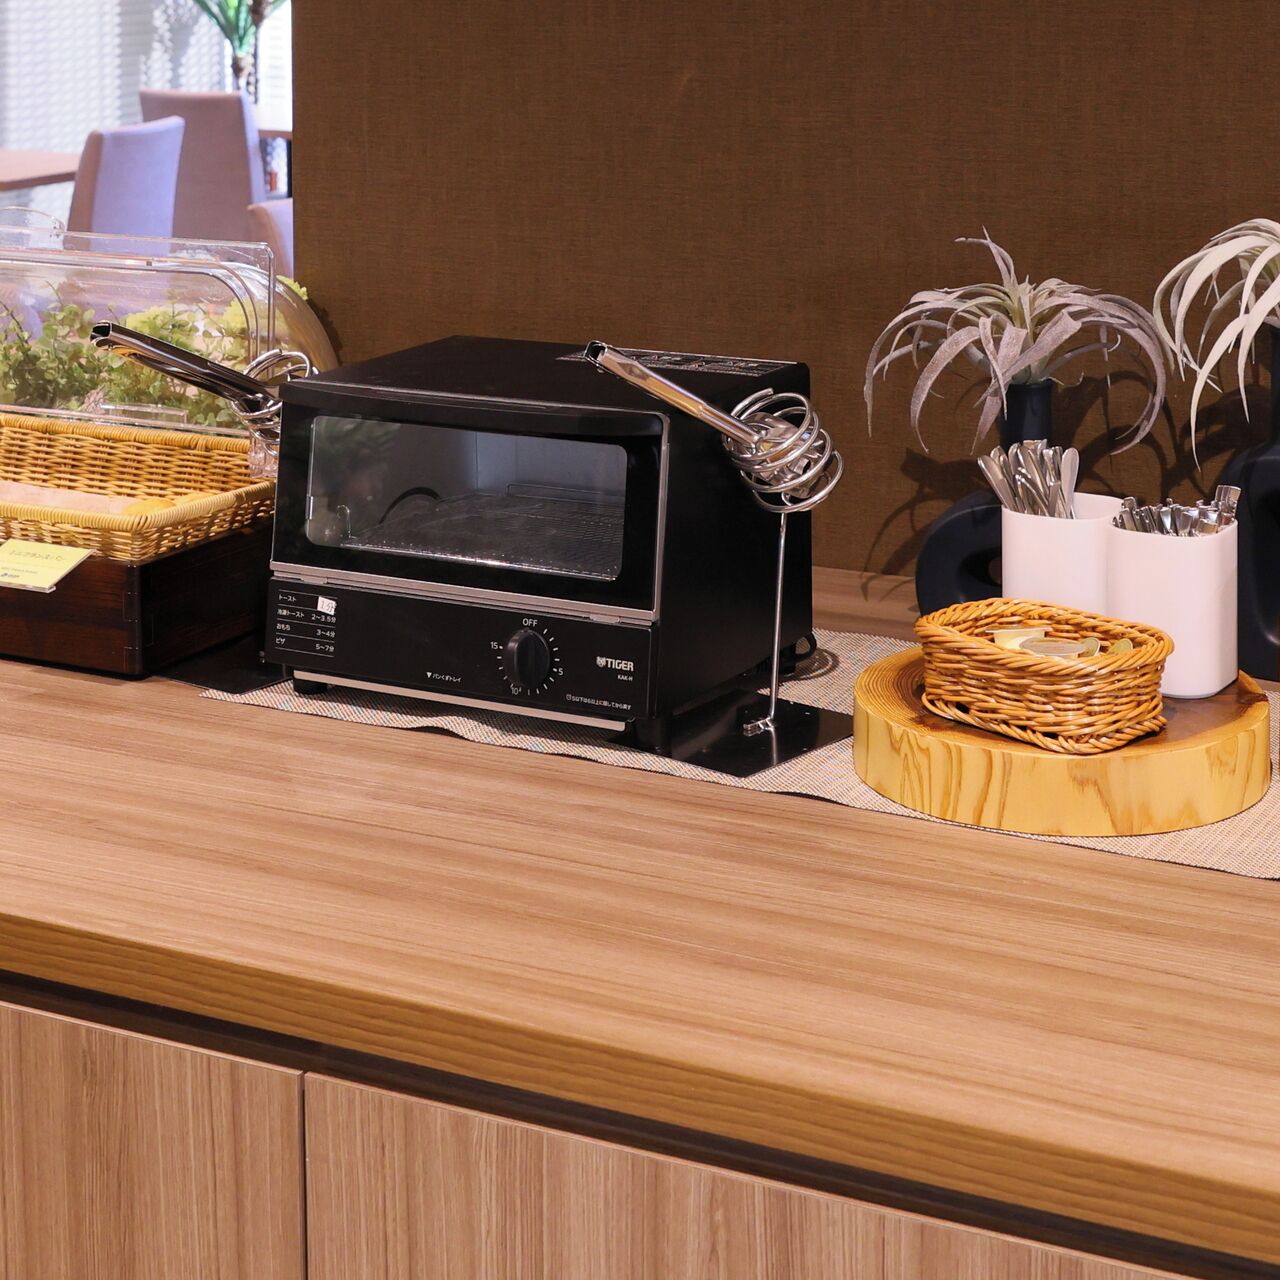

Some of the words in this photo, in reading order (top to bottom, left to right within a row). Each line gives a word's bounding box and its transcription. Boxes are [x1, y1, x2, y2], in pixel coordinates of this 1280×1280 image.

[278, 594, 297, 602] トースト
[522, 617, 538, 627] OFF
[276, 623, 291, 631] おもち
[275, 637, 286, 645] ピザ
[490, 641, 499, 650] 15
[606, 657, 634, 672] TIGER
[558, 667, 564, 676] 5
[511, 687, 519, 695] 10
